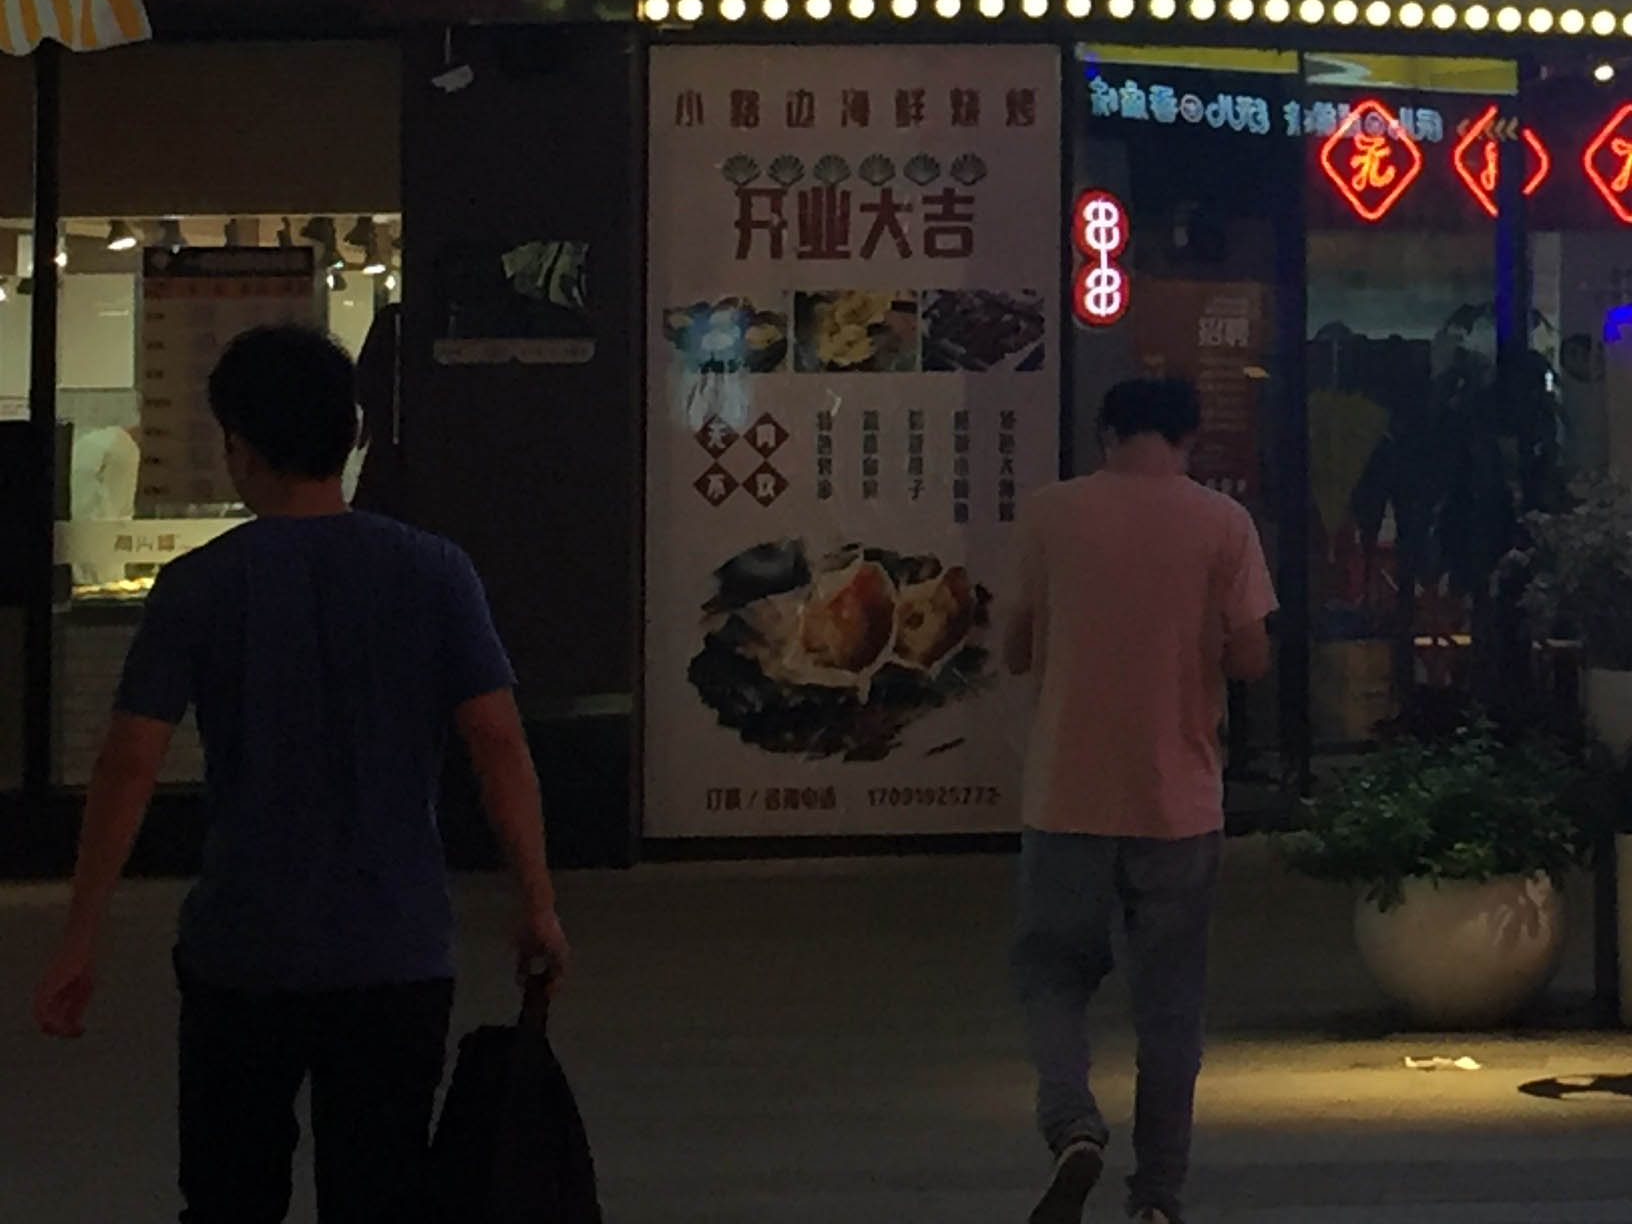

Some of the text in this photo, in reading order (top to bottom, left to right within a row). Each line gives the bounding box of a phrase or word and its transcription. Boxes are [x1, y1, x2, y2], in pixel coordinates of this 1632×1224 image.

[674, 87, 1038, 129] 小路边海鲜烧烤
[733, 186, 976, 261] 开业大吉
